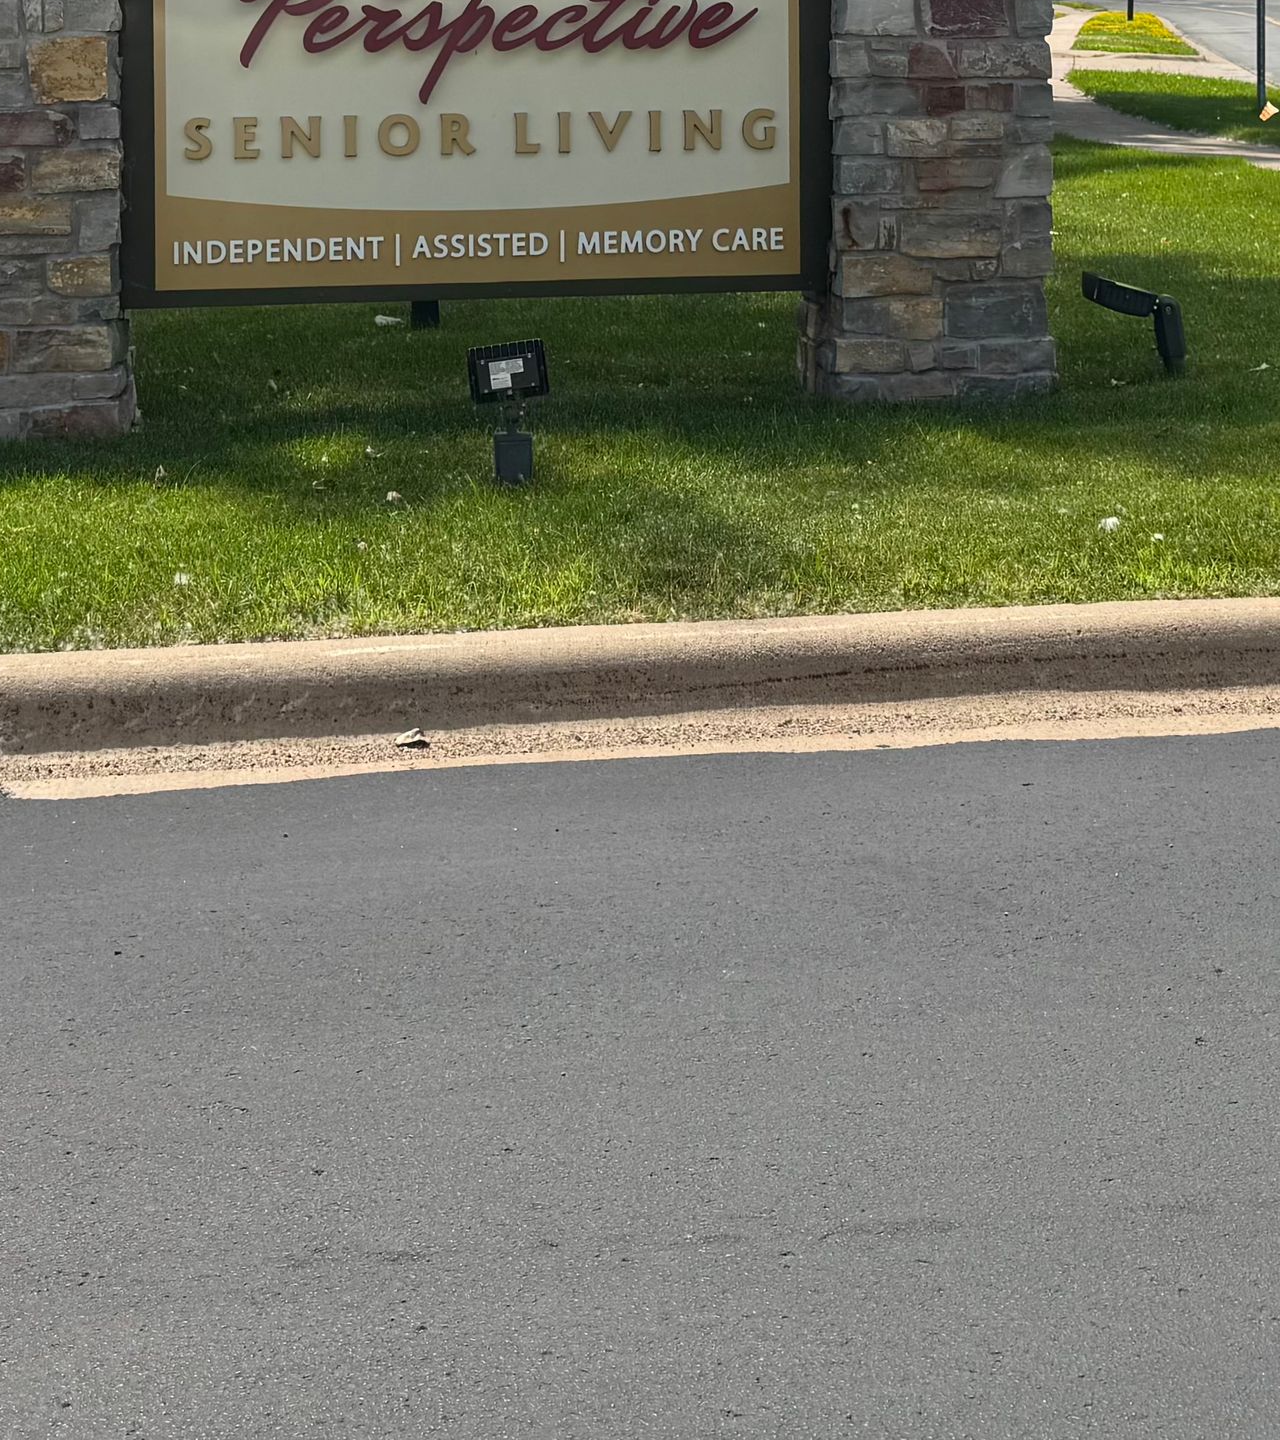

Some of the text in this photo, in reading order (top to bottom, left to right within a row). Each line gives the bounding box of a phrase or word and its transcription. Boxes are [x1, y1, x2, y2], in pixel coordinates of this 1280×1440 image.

[183, 108, 777, 161] SENIOR LIVING
[172, 235, 385, 266] INDEPENDENT
[411, 232, 550, 259] ASSISTED
[576, 228, 704, 255] MEMORY
[711, 226, 785, 252] CARE
